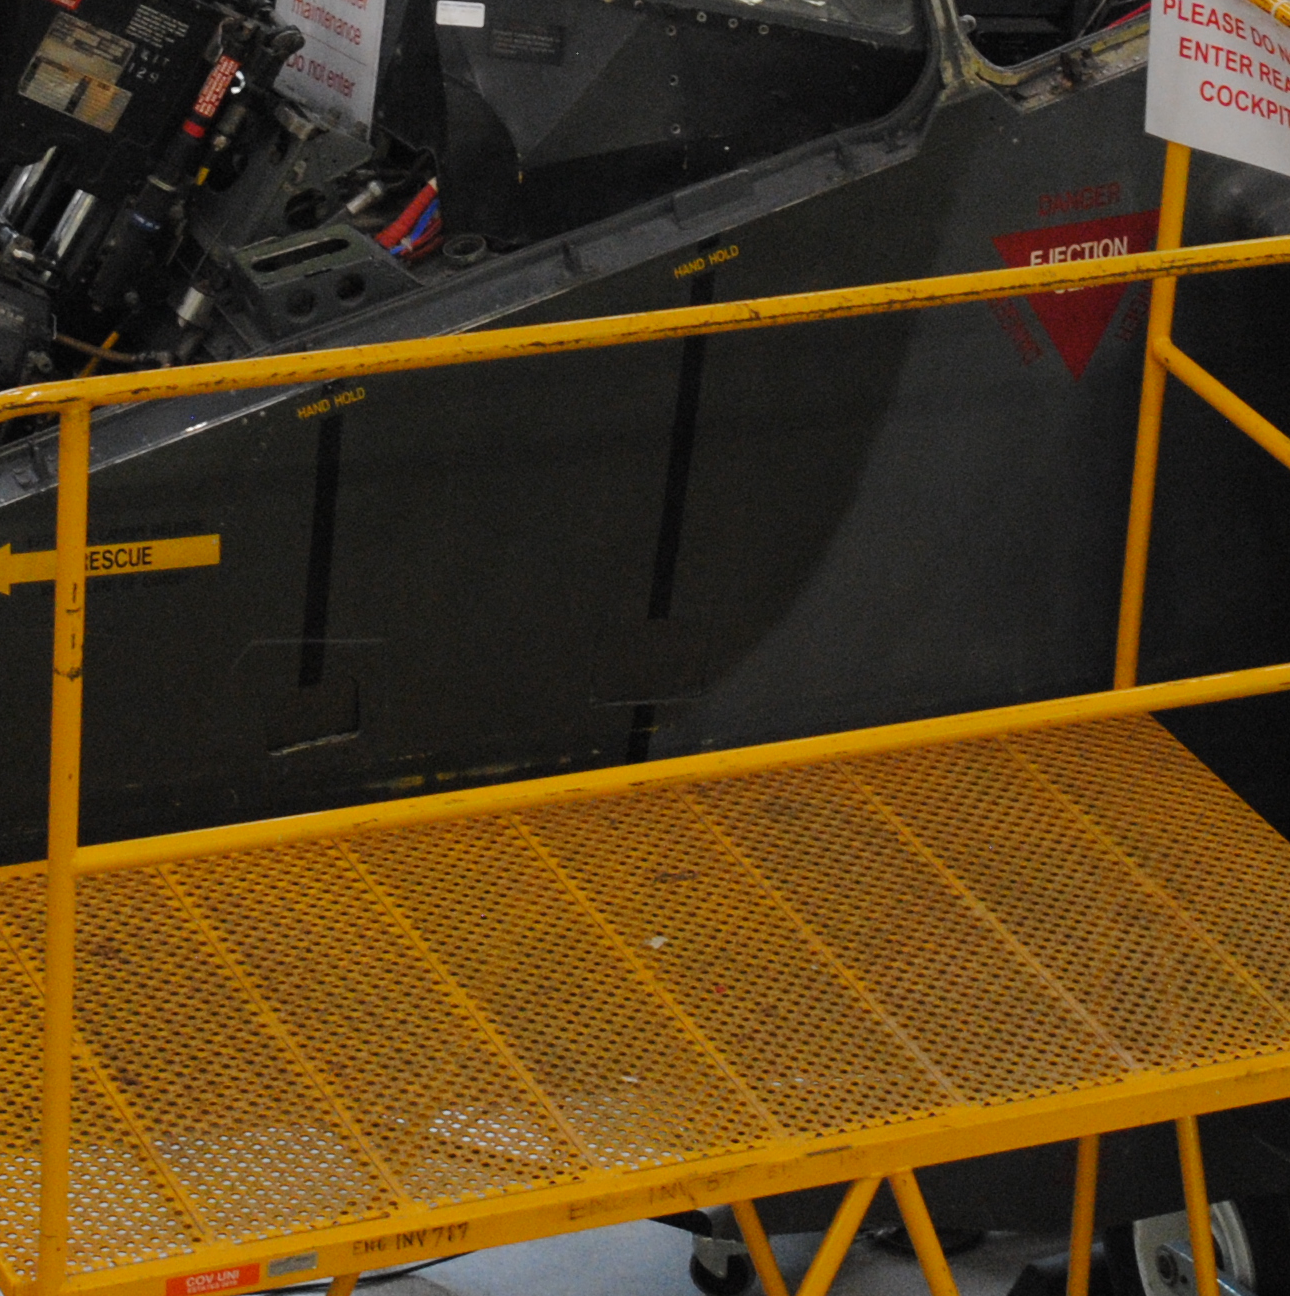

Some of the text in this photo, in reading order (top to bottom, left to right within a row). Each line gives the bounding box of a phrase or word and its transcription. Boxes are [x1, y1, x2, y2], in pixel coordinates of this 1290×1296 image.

[1250, 25, 1276, 56] DO
[128, 62, 159, 84] 129
[1178, 36, 1254, 78] ENTER
[286, 53, 357, 99] Do not enter
[1037, 181, 1122, 218] DANGER
[673, 245, 739, 279] HAND HOLD
[1030, 235, 1129, 267] EJECTION
[295, 387, 366, 419] HAND HOLD
[85, 546, 153, 572] ESCUE
[396, 1229, 427, 1250] INV
[217, 1269, 240, 1282] UNI
